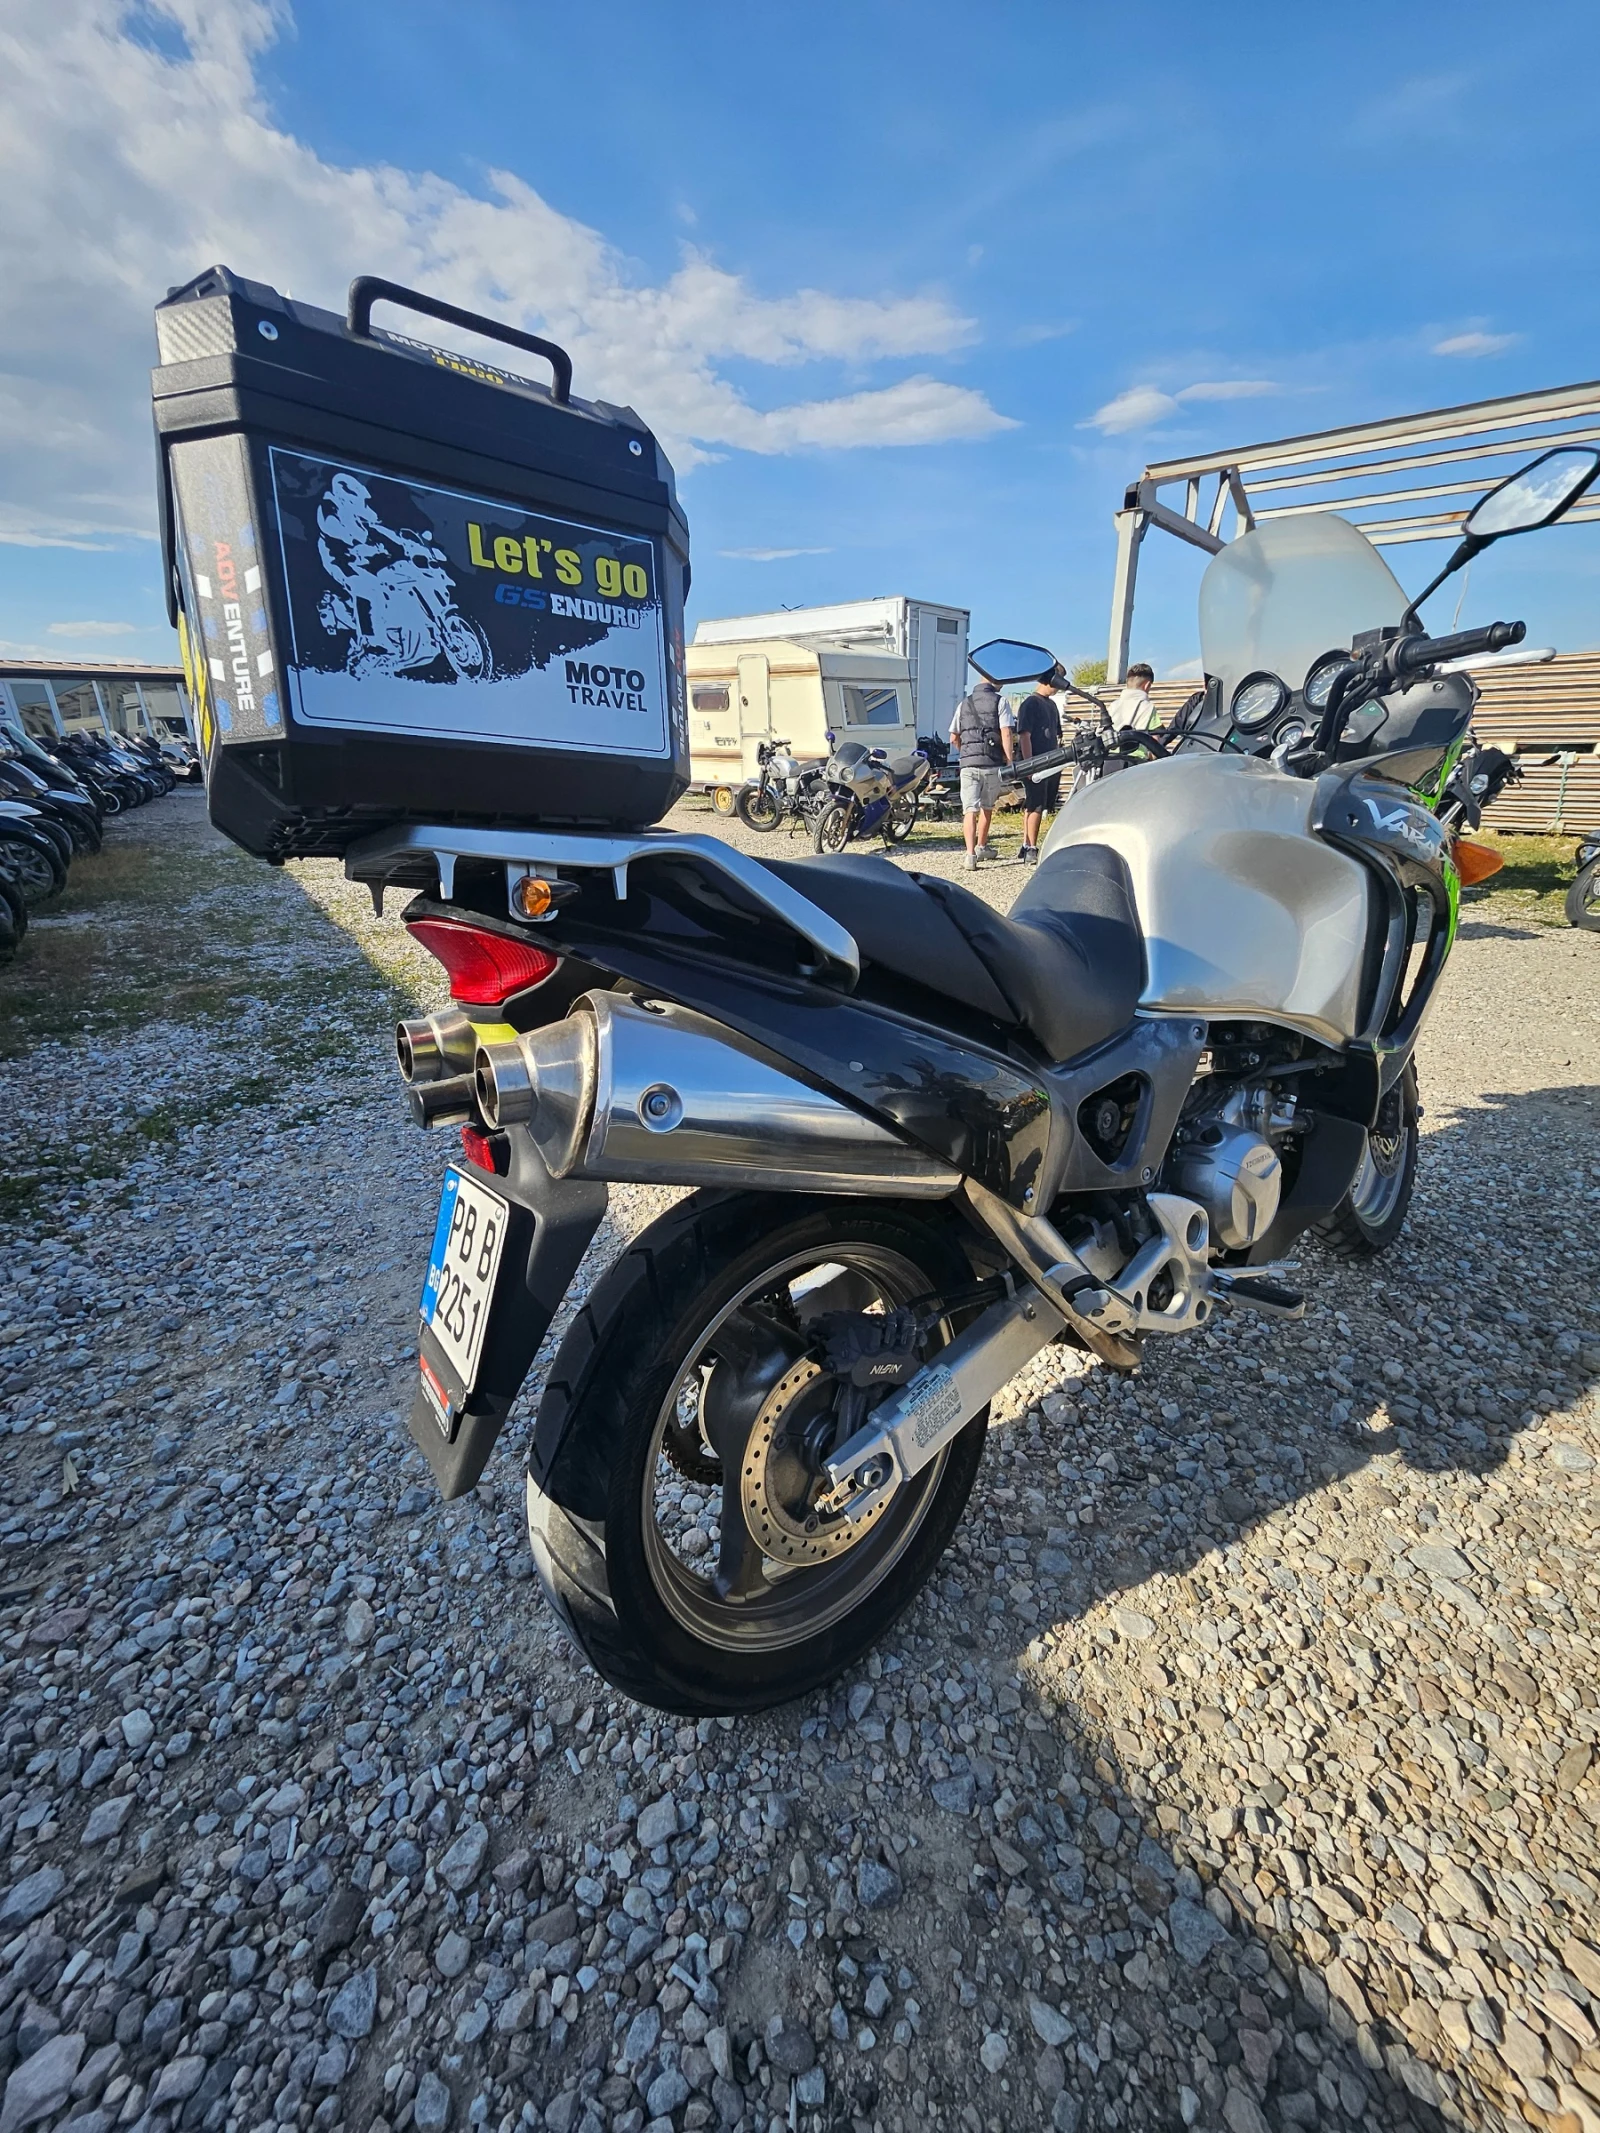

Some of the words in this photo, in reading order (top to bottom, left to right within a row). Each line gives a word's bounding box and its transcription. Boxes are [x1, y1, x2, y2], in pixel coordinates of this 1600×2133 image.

[468, 523, 583, 586] Let's
[595, 557, 648, 599] go
[494, 583, 547, 610] GS
[549, 592, 641, 629] ENDURO
[564, 660, 646, 692] MOTO
[566, 685, 648, 712] TRAVEL
[448, 1195, 478, 1263] PB
[476, 1218, 497, 1283] B
[428, 1263, 441, 1293] BG
[435, 1262, 481, 1360] 2251
